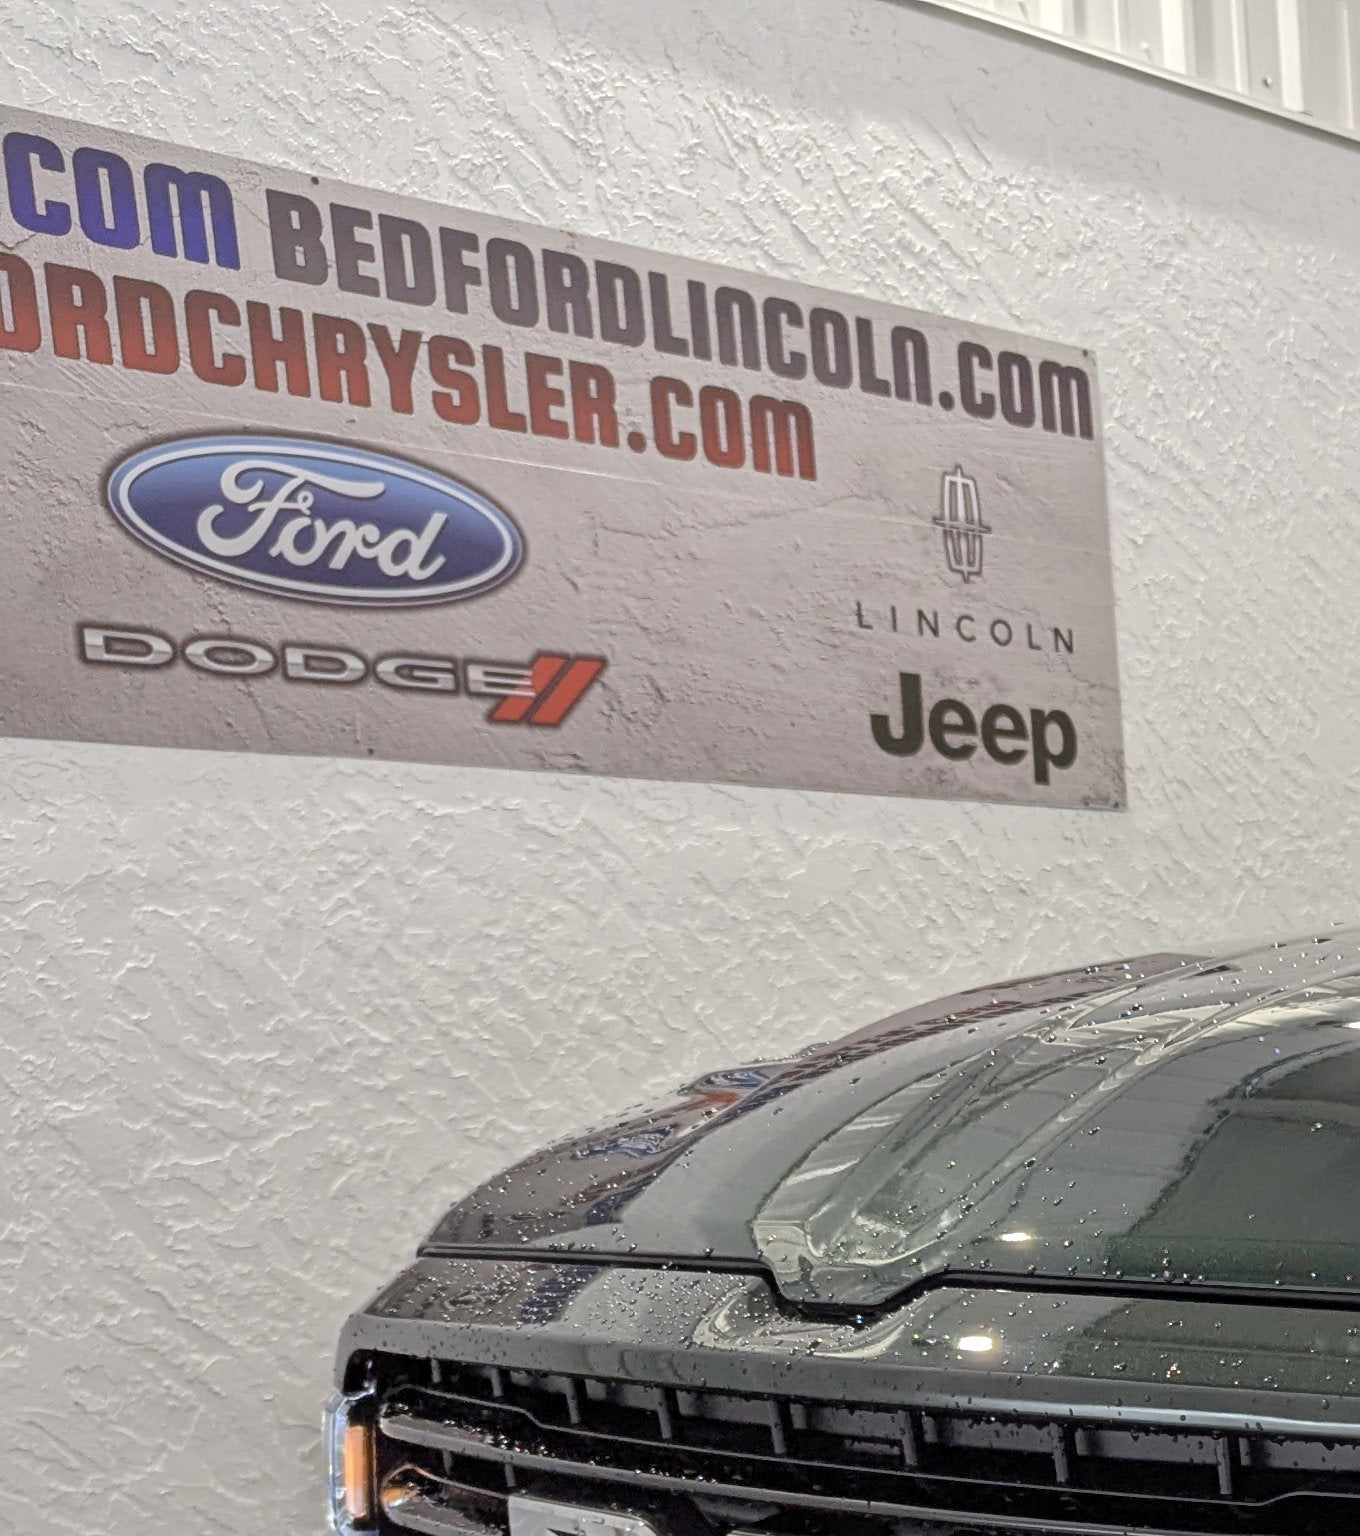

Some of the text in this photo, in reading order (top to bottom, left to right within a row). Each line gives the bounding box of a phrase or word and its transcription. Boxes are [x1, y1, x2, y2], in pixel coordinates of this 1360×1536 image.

[266, 187, 1095, 441] BEDFORDLINCOLN.COM
[196, 459, 446, 582] Ford
[79, 623, 538, 699] DODGE
[856, 600, 1075, 655] LINCOLN
[869, 671, 1079, 786] Jeep
